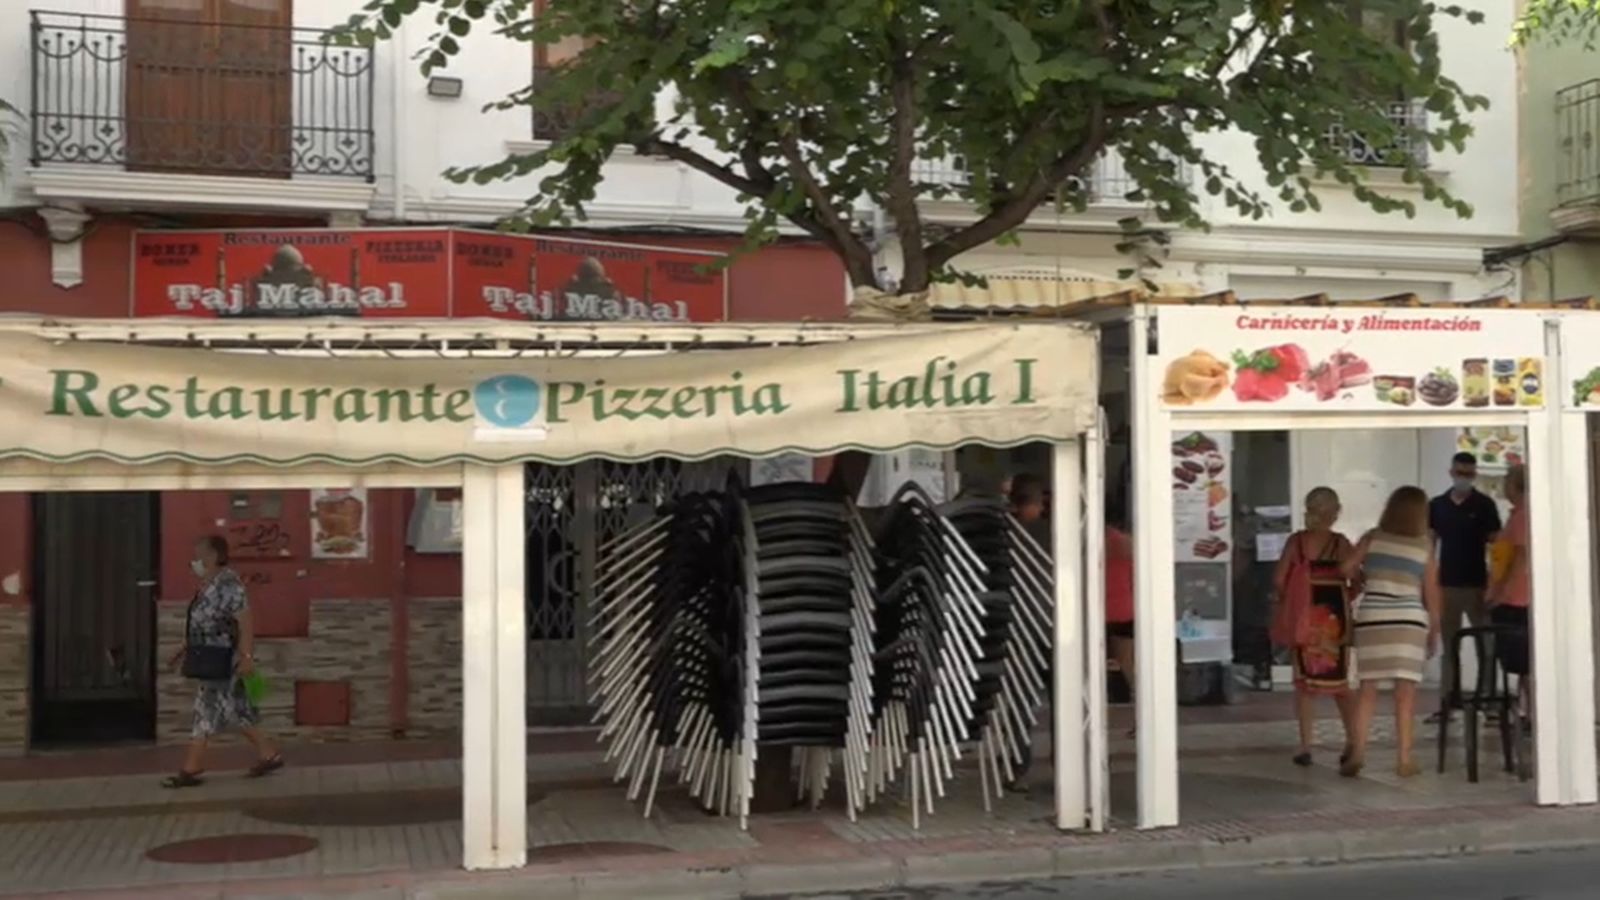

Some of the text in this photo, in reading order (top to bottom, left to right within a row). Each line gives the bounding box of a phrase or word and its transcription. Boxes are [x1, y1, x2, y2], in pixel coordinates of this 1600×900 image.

[224, 231, 350, 246] Restaurante
[535, 239, 645, 261] Restaurante
[167, 282, 407, 313] Taj Mahal
[482, 286, 689, 321] Taj Mahal
[1236, 314, 1481, 333] Carnicería y Alimentación
[45, 356, 1038, 424] Restaurante Pizzeria Italia I
